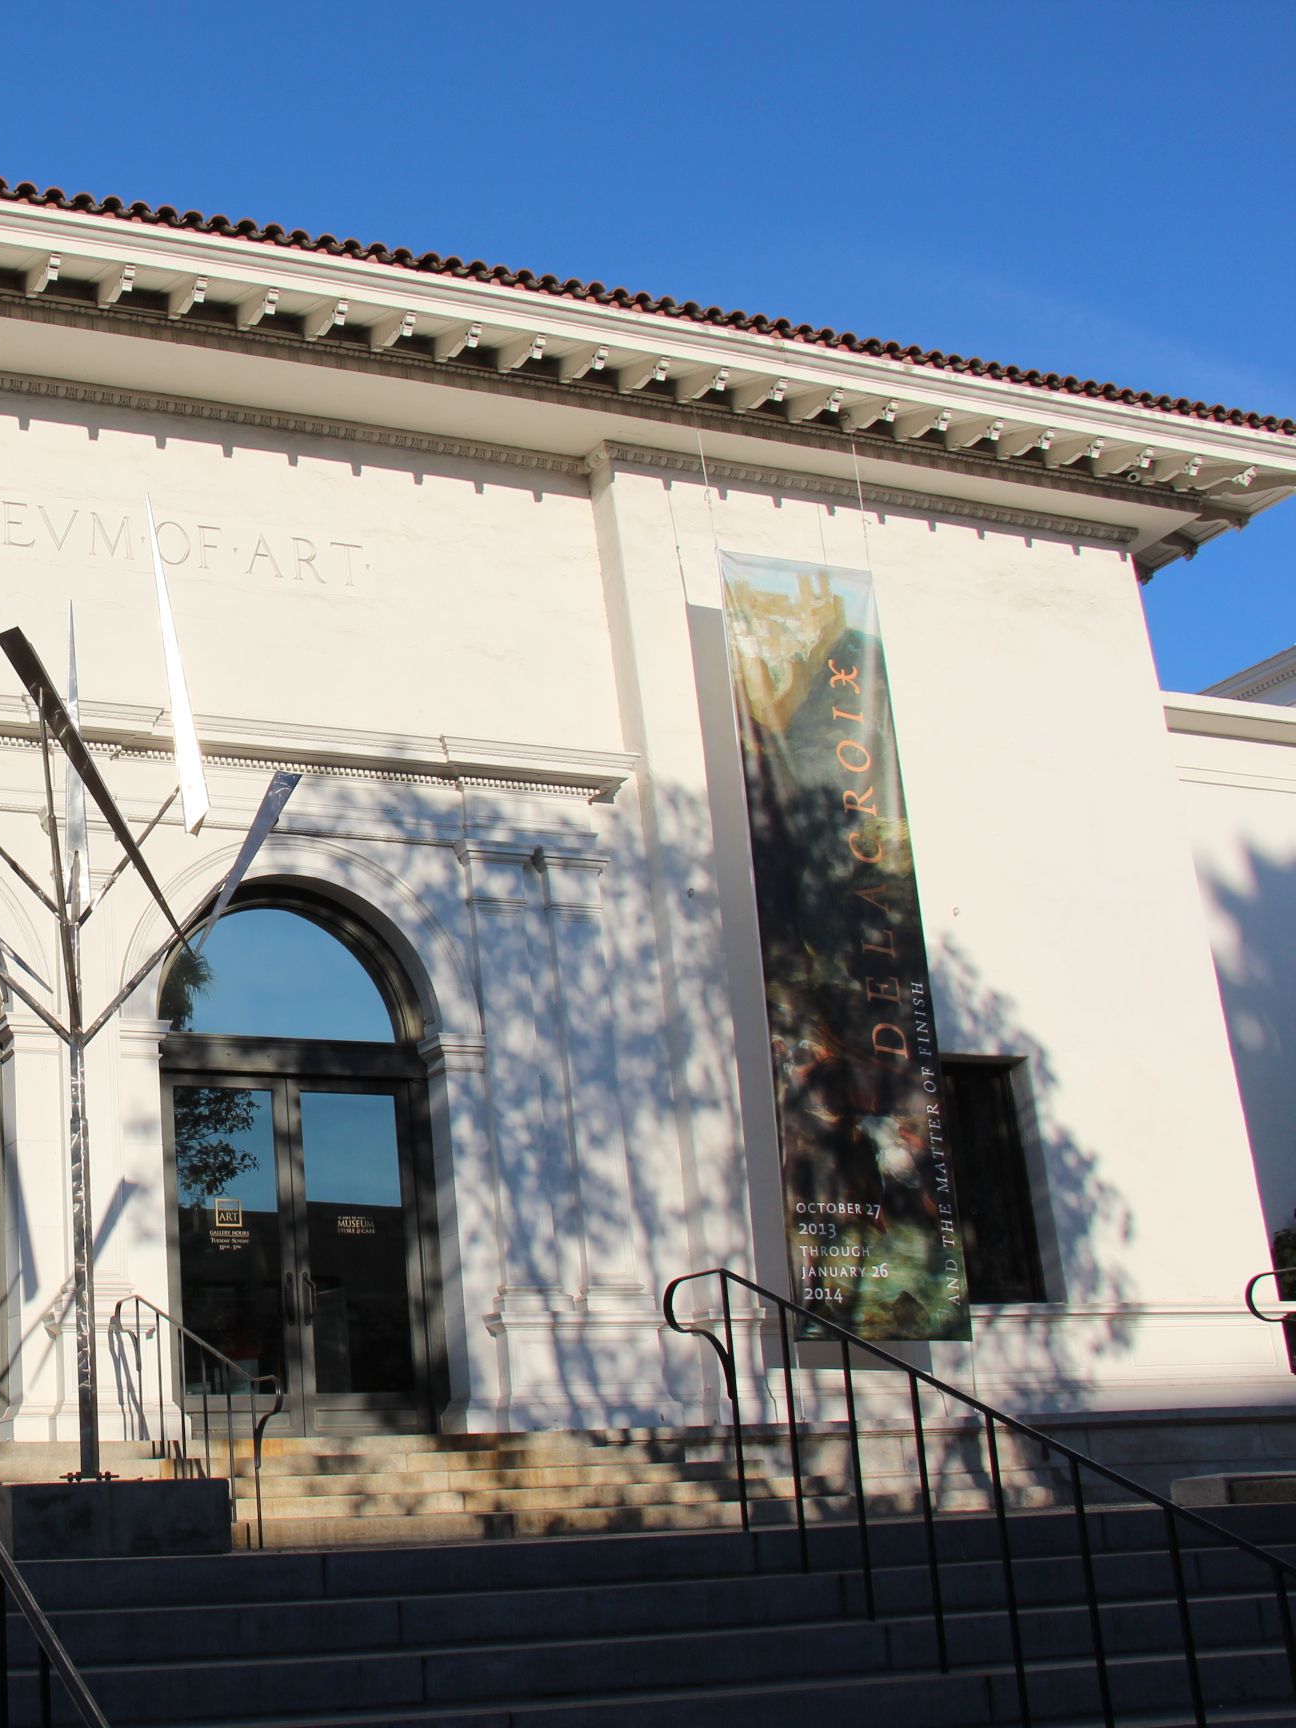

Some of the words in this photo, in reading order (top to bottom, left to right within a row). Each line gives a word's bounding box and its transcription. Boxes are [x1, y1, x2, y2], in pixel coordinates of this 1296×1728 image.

[154, 520, 222, 570] OF
[244, 532, 364, 587] ART
[827, 658, 910, 1061] DELACROIX
[910, 982, 932, 1056] FINISH
[921, 1066, 937, 1093] OF
[926, 1103, 949, 1193] MATTER
[219, 1211, 239, 1222] ART
[796, 1202, 862, 1214] OCTOBER
[866, 1203, 881, 1220] 27
[337, 1219, 375, 1229] MUSEUM
[798, 1223, 837, 1239] 2013
[938, 1204, 956, 1248] THE
[799, 1245, 871, 1257] THROUGH
[801, 1266, 866, 1280] JANUARY
[871, 1262, 889, 1278] 26
[944, 1259, 961, 1306] AND
[804, 1287, 843, 1304] 2014
